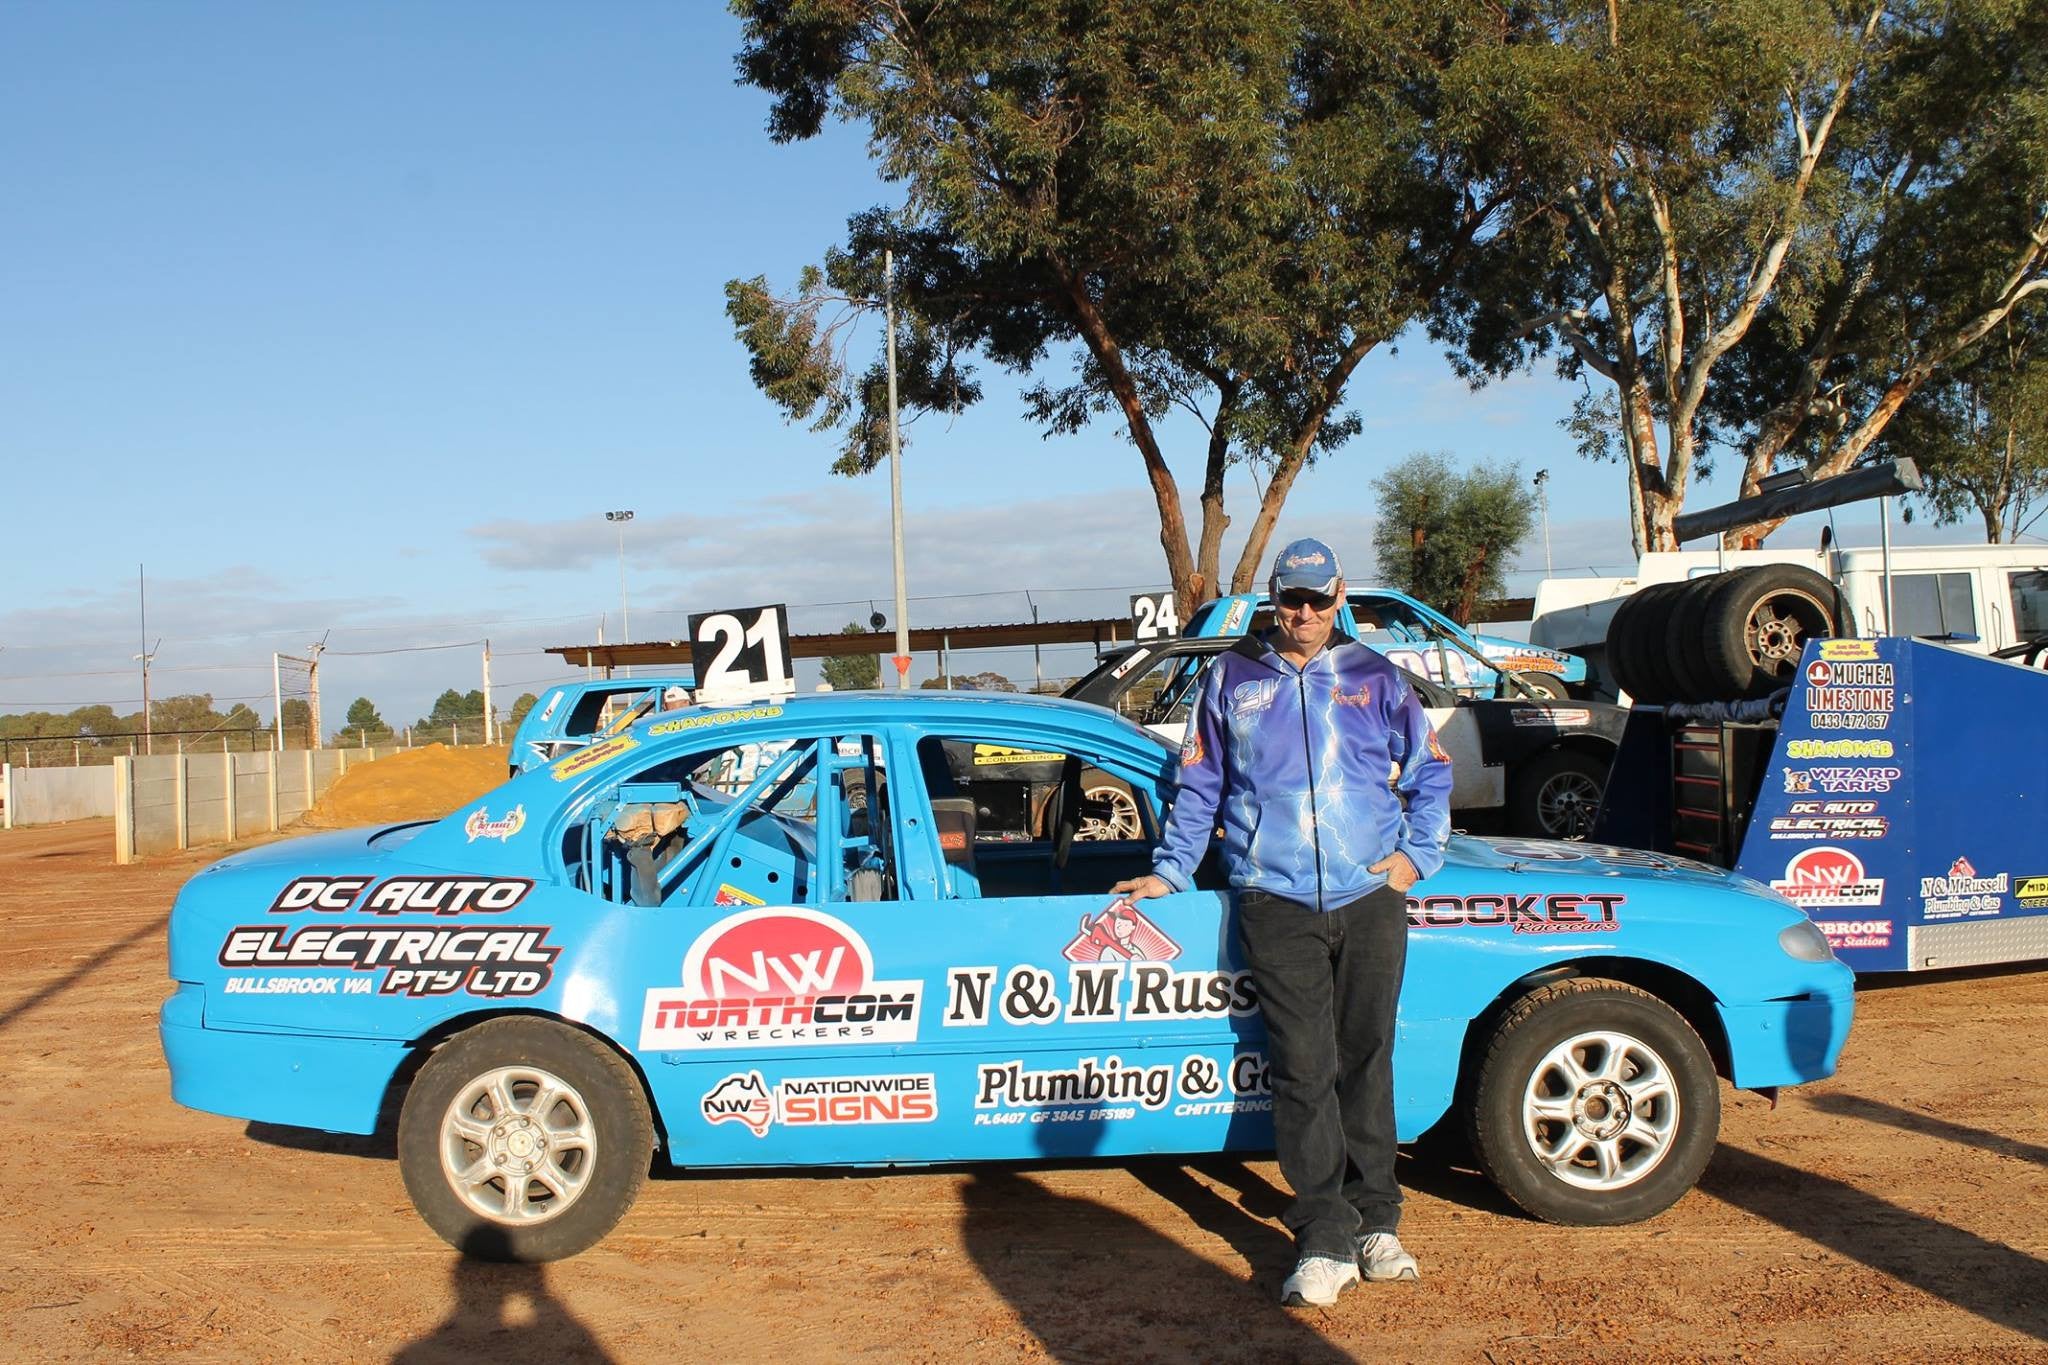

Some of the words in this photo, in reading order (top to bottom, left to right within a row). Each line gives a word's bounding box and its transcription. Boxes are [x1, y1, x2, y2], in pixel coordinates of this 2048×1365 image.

[1134, 593, 1179, 639] 24
[698, 608, 787, 692] 21
[1834, 664, 1893, 685] MUCHEA
[1233, 677, 1275, 715] 21
[1807, 687, 1893, 711] LIMESTONE
[1811, 713, 1841, 728] 0433
[1843, 713, 1864, 728] 472
[1867, 714, 1888, 729] 857
[986, 754, 1054, 763] CONTRACTING
[1811, 768, 1900, 779] WIZARD
[1822, 781, 1889, 791] TARPS
[1789, 802, 1820, 814] DC
[1821, 802, 1876, 814] AUTO
[1770, 818, 1886, 831] ELECTRICAL
[1830, 830, 1858, 838] PTY
[1858, 829, 1884, 838] LTD
[1795, 864, 1853, 885] NW
[1921, 879, 1933, 896] N
[1935, 879, 1948, 894] &
[1949, 878, 1962, 894] M
[1963, 874, 2007, 893] Russell
[2027, 882, 2048, 892] MID
[282, 881, 362, 910] DC
[372, 880, 526, 910] AUTO
[1926, 898, 1969, 913] Plumbing
[1982, 896, 2000, 908] Gas
[1516, 921, 1618, 932] Racecars
[223, 931, 557, 964] ELECTRICAL
[1843, 936, 1888, 947] Station
[386, 970, 464, 992] PTY
[464, 969, 544, 993] LTD
[707, 946, 846, 998] NW
[224, 977, 338, 993] BULLSBROOK
[342, 977, 372, 993] WA
[950, 973, 990, 1020] N
[1005, 970, 1055, 1018] &
[1071, 968, 1119, 1017] M
[654, 993, 916, 1029] NORTHCOM
[696, 1025, 875, 1043] WRECKERS
[784, 1077, 930, 1095] NATIONWIDE
[980, 1059, 1173, 1107] Plumbing
[1181, 1059, 1219, 1095] &
[703, 1098, 771, 1113] NWS
[785, 1094, 932, 1124] SIGNS
[974, 1111, 1026, 1126] PL6407
[1030, 1110, 1047, 1124] GF
[1050, 1109, 1084, 1122] 3845
[1088, 1107, 1136, 1121] BF5189
